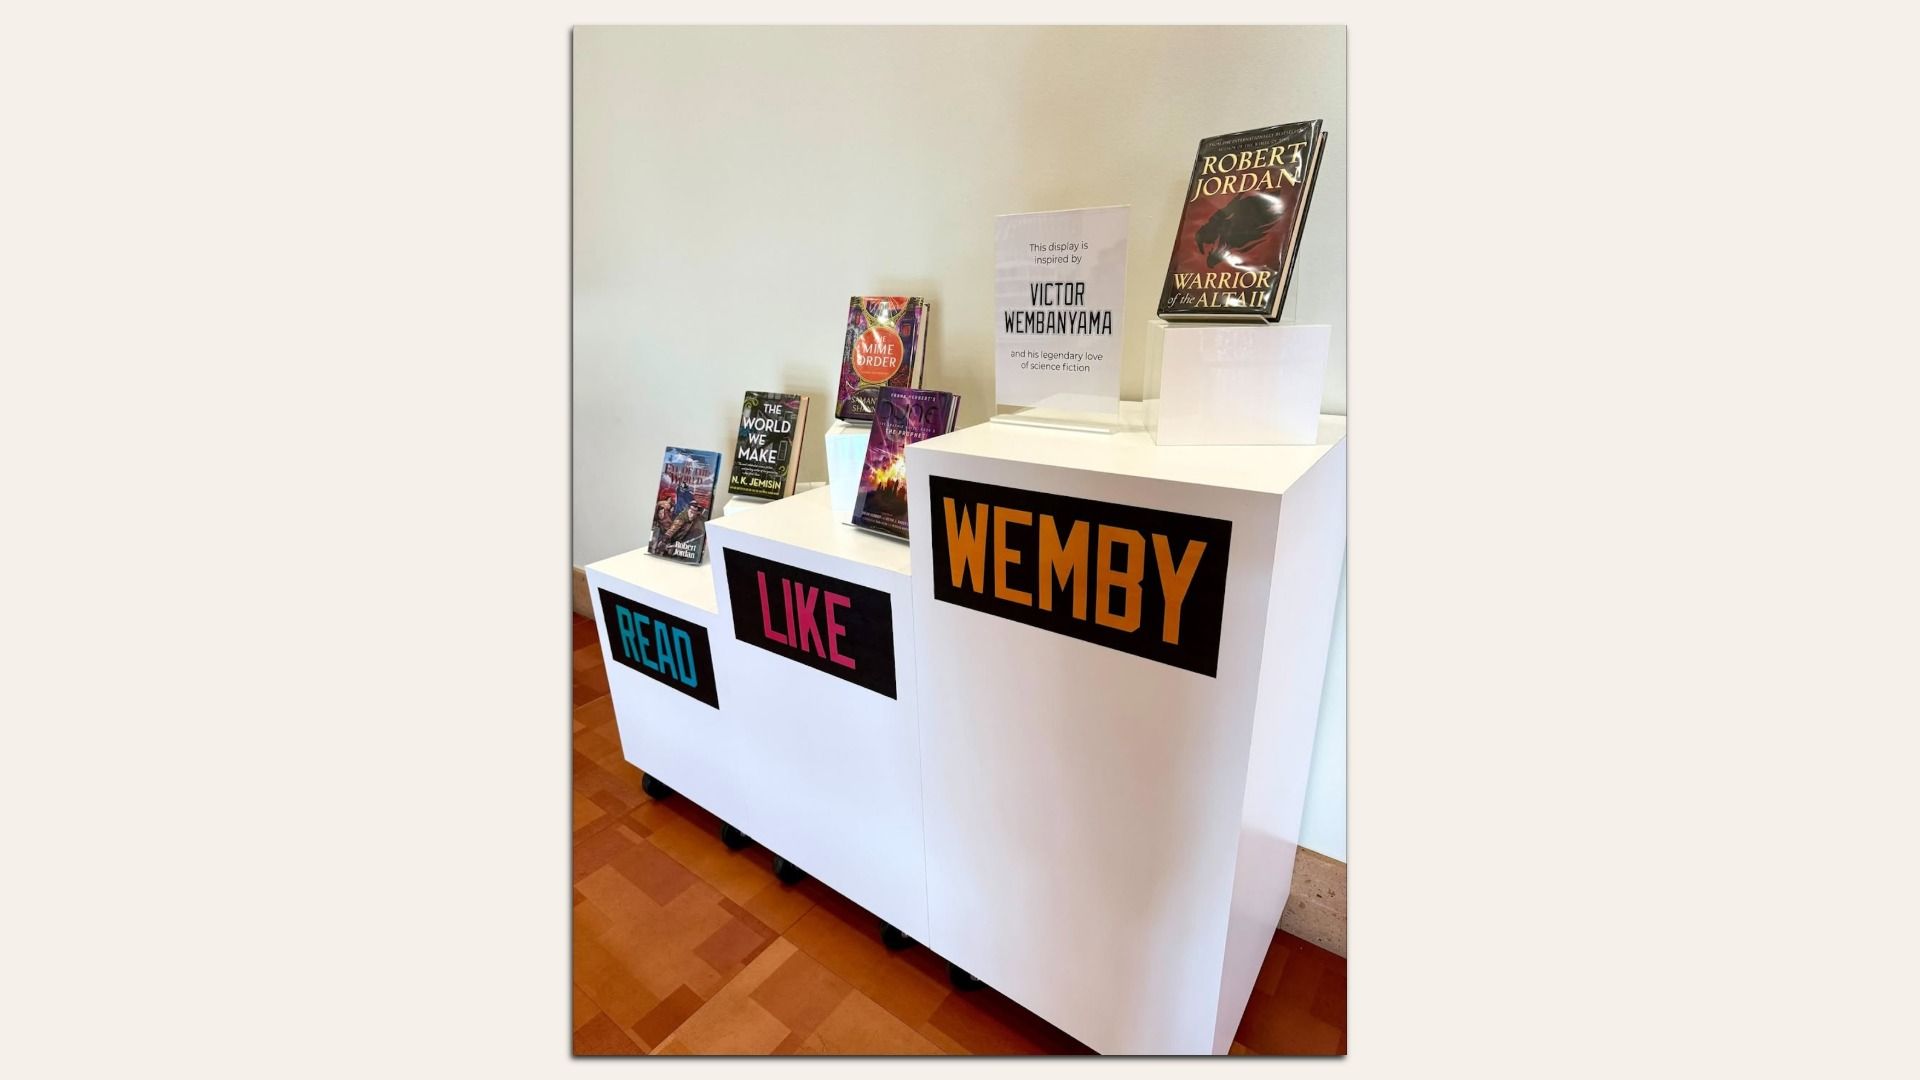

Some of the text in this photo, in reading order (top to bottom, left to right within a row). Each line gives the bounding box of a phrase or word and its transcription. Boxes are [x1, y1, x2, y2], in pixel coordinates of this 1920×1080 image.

[1201, 141, 1307, 176] ROBERT
[1190, 167, 1300, 203] JORDAN
[1029, 241, 1088, 252] This display is
[1034, 254, 1082, 265] inspired by
[1173, 271, 1271, 290] WARRIOR
[1030, 282, 1085, 306] VICTOR
[1167, 293, 1181, 308] of
[1180, 293, 1196, 305] the
[1004, 310, 1112, 335] WEMBANYAMA
[863, 344, 895, 356] MIME
[1010, 350, 1103, 361] and his legendary love
[857, 355, 897, 368] ORDER
[1021, 361, 1090, 372] of science fiction
[764, 404, 782, 414] THE
[742, 416, 791, 433] WORLD
[748, 433, 767, 445] WE
[738, 446, 777, 463] MAKE
[731, 475, 781, 489] N. K. JEMISIN
[675, 541, 697, 551] Robert
[673, 548, 696, 559] Jordan
[943, 496, 1208, 645] WEMBY
[757, 570, 856, 670] LIKE
[615, 604, 698, 689] READ
